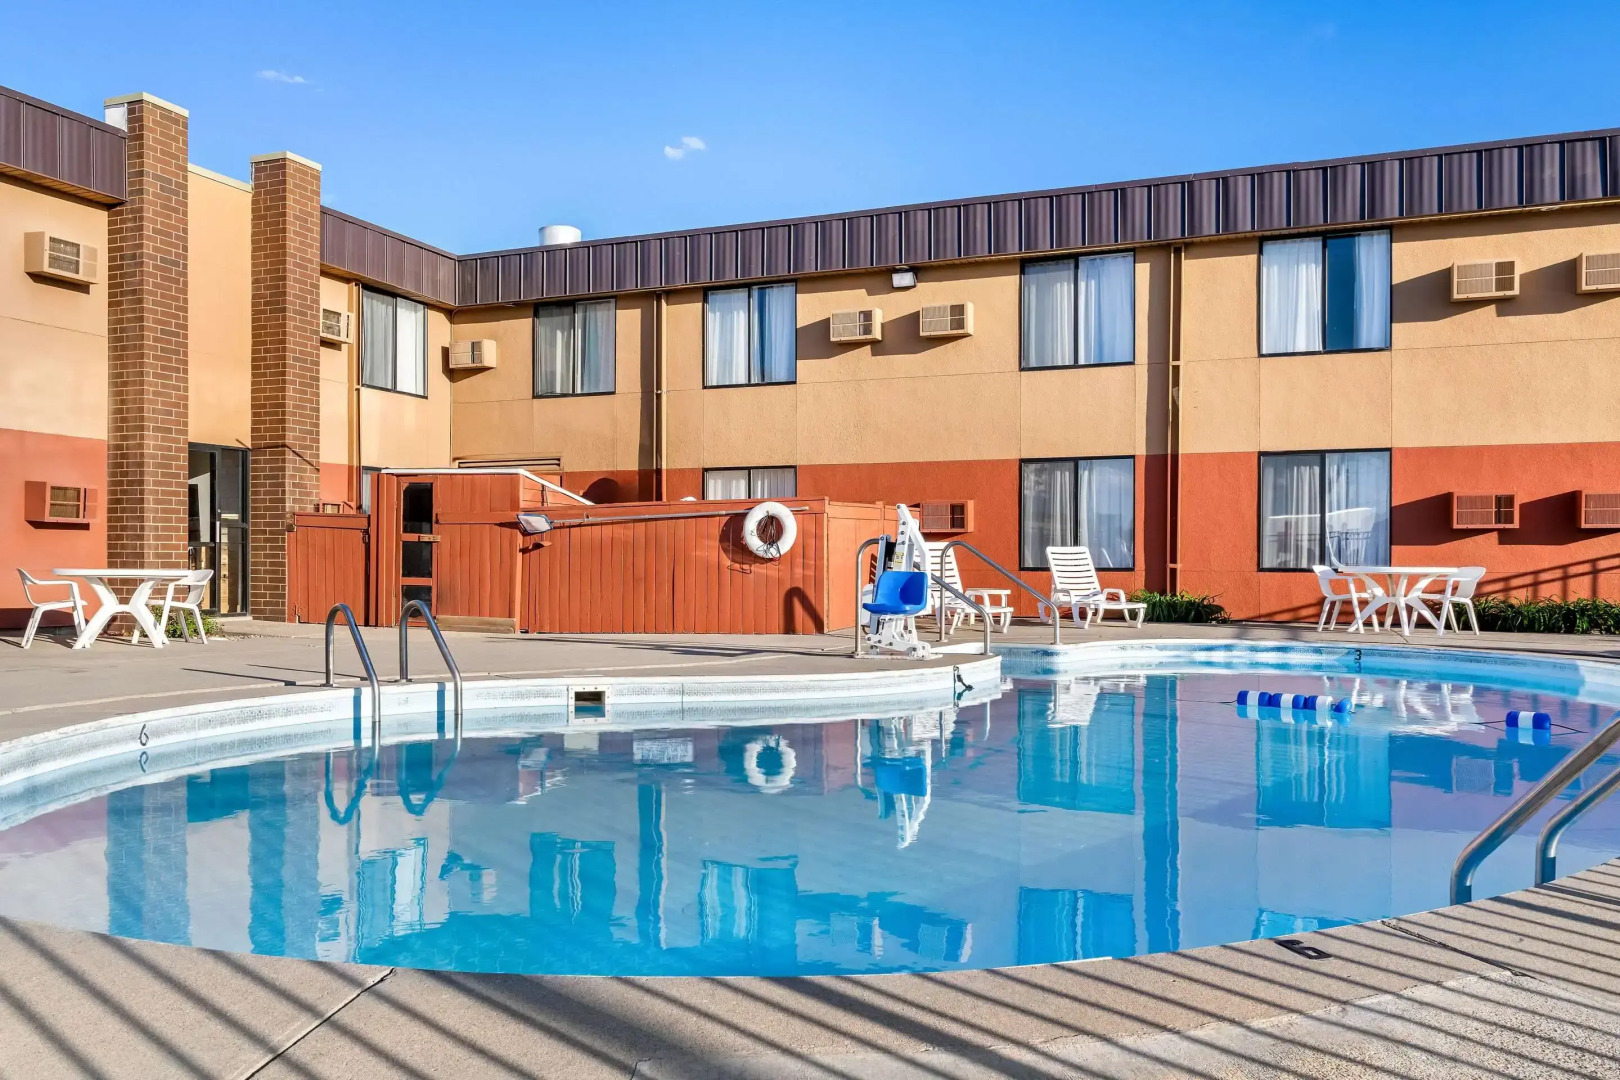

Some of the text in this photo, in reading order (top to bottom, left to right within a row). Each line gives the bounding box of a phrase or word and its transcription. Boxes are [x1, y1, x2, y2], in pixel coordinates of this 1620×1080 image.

[1354, 649, 1362, 661] 3
[138, 723, 149, 746] 6
[1274, 939, 1332, 960] 6
